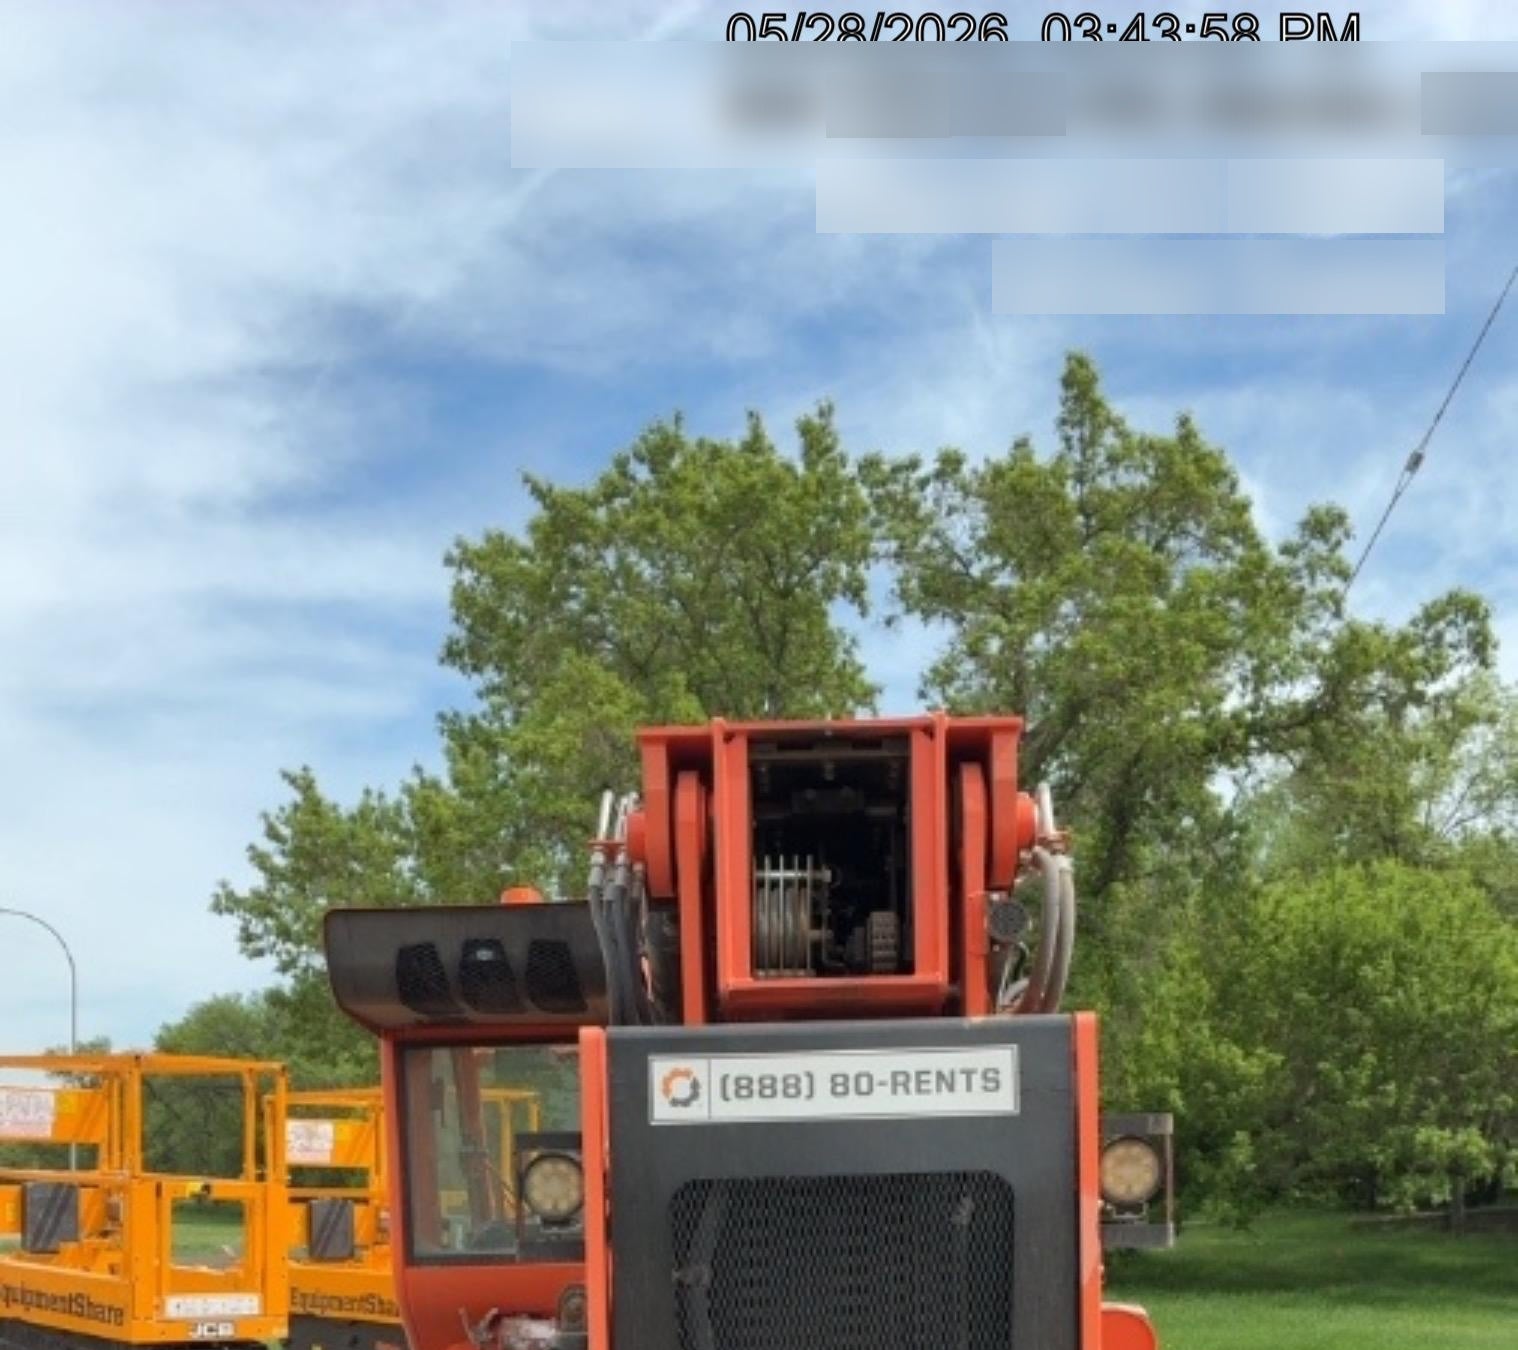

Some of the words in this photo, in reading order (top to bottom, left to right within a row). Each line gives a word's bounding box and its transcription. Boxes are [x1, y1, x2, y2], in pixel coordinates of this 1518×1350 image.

[720, 1071, 814, 1101] (888)
[829, 1068, 1001, 1096] 80-RENTS
[0, 1282, 124, 1327] quipmentShare
